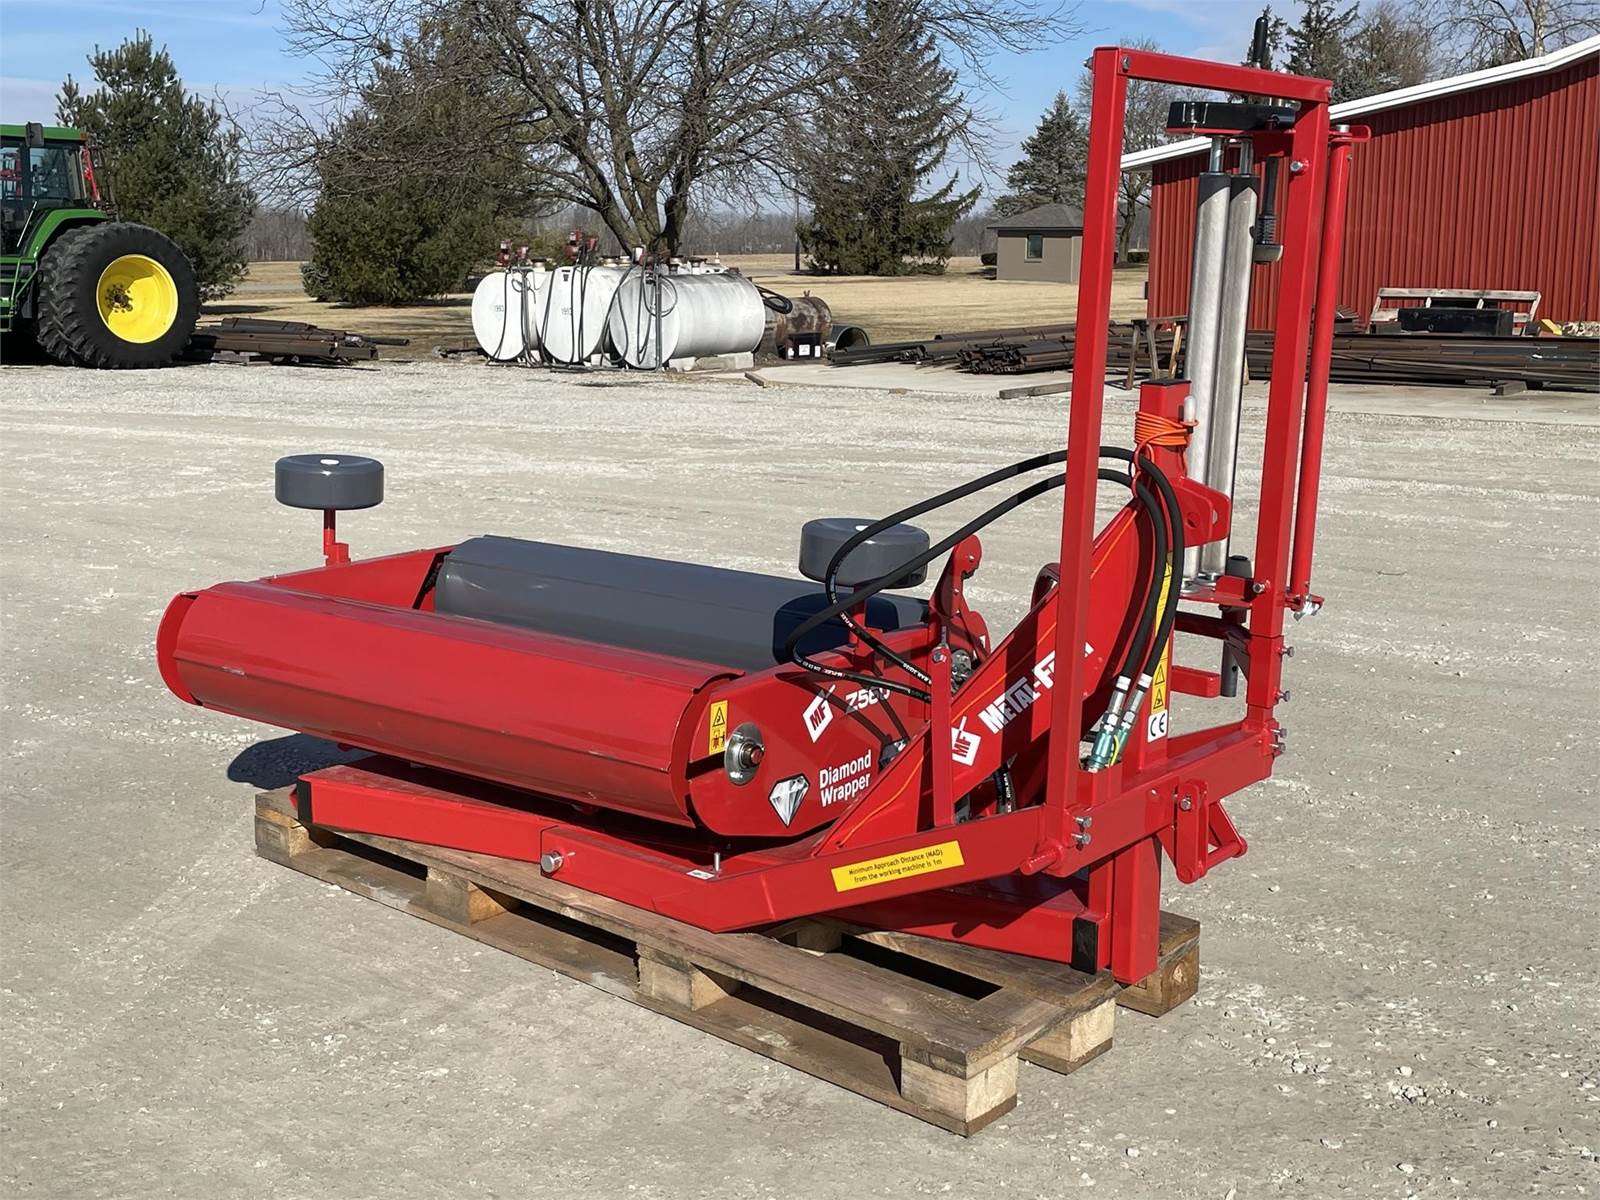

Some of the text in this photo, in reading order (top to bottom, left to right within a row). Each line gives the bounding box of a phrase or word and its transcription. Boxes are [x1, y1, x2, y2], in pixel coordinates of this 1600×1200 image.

[977, 642, 1095, 735] METAL-F
[809, 703, 827, 731] MF
[1149, 713, 1165, 737] CE
[952, 734, 972, 760] MF
[819, 749, 872, 789] Diamond
[820, 772, 871, 808] Wrapper
[848, 849, 943, 875] Minimum Approach Distance (MAD)
[854, 858, 943, 884] from the working machine is 1m
